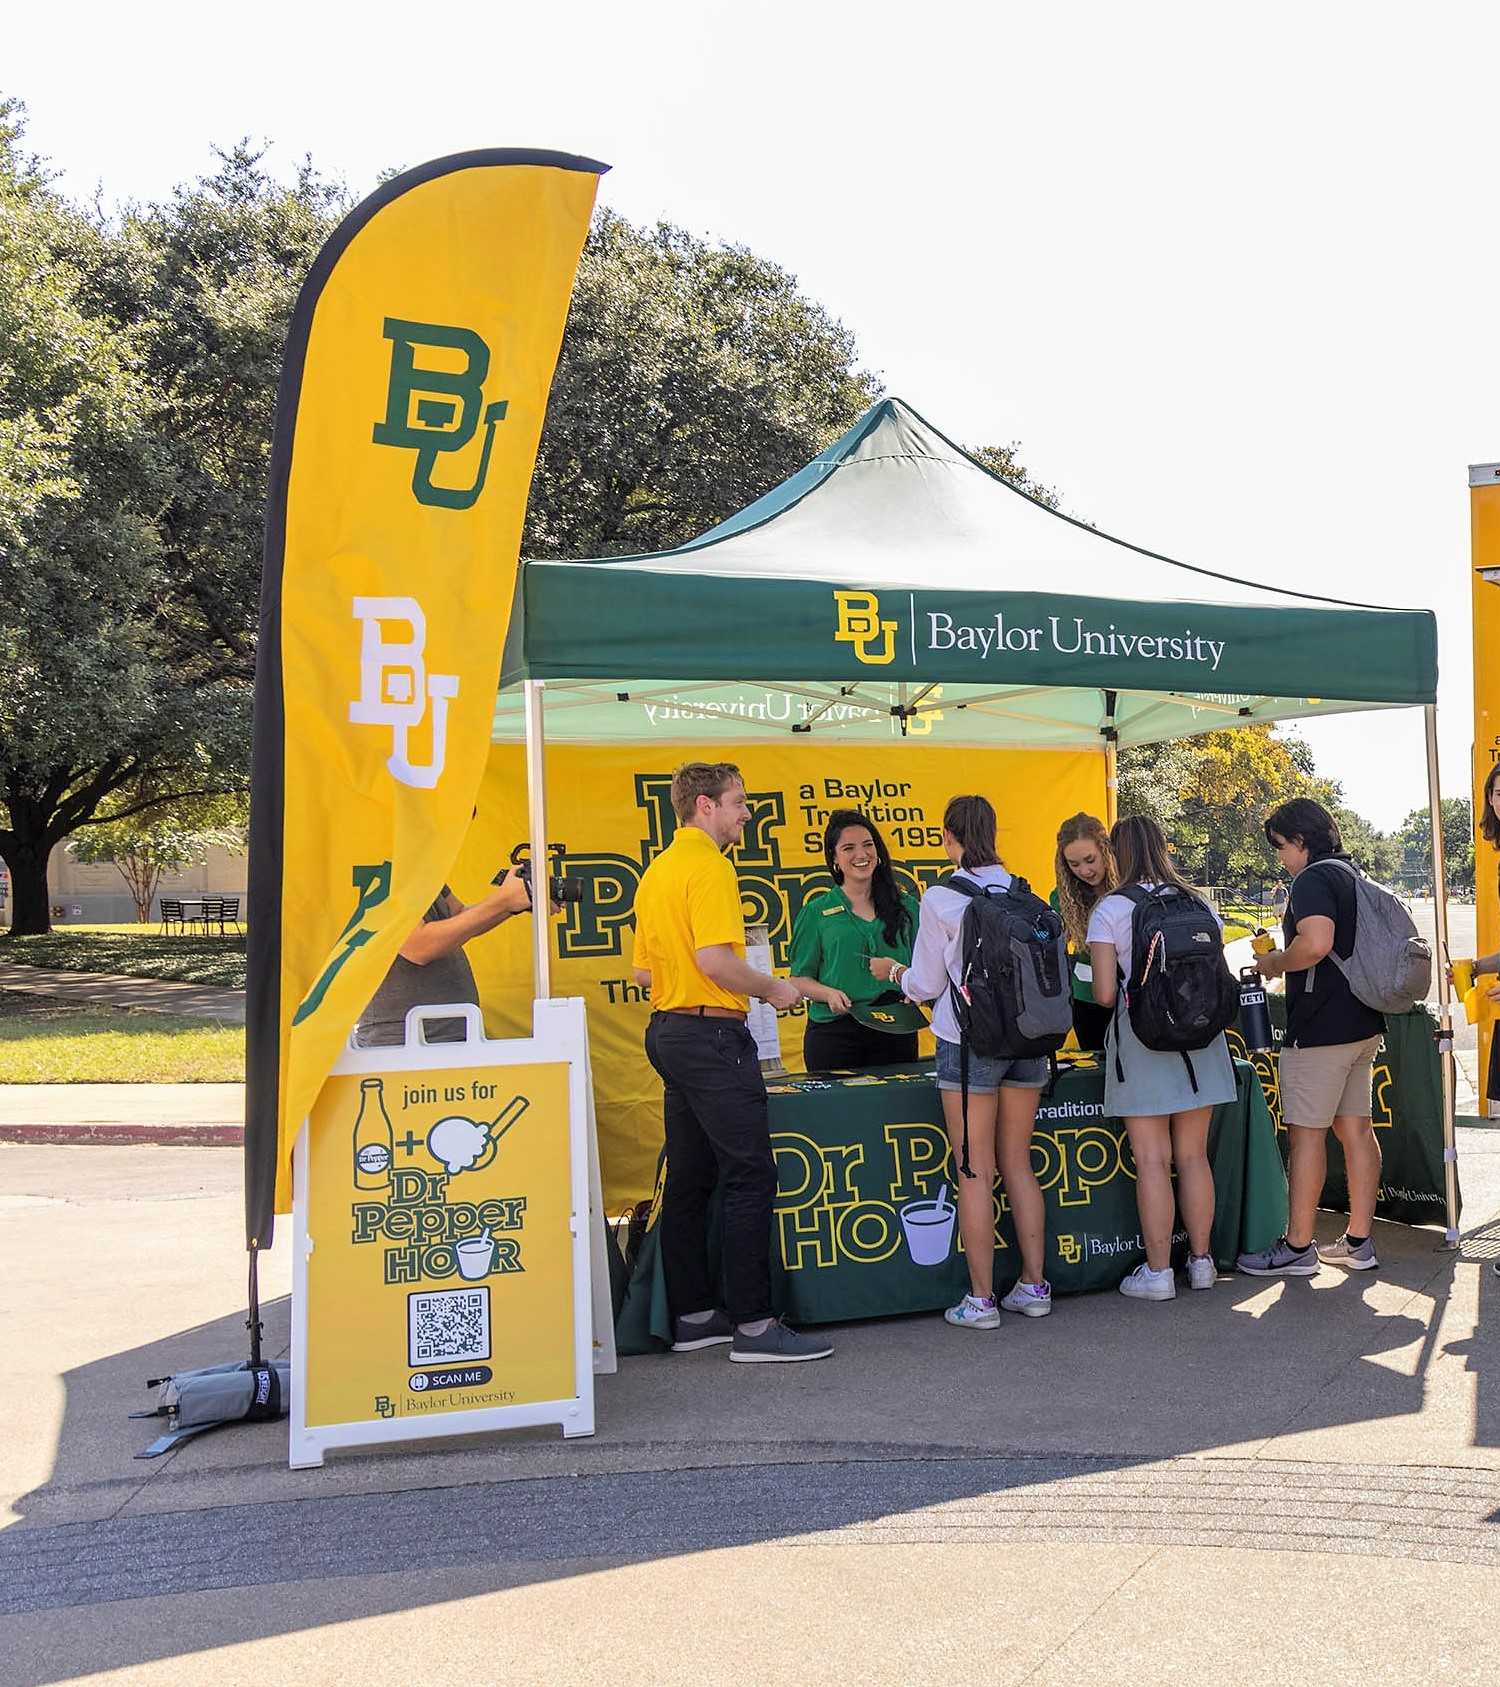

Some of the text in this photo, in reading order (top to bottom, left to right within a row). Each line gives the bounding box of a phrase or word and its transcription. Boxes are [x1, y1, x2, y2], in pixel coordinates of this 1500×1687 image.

[373, 317, 508, 510] BU
[833, 590, 1225, 671] BU Baylor University
[348, 596, 459, 789] BU
[799, 778, 911, 803] a Baylor
[800, 803, 924, 827] Trition
[891, 827, 943, 848] 195
[1241, 993, 1263, 1004] YETI
[402, 1080, 498, 1110] join us for
[388, 1167, 450, 1208] Dr
[352, 1196, 527, 1247] Pepper
[384, 1238, 526, 1285] HOR
[1057, 1234, 1082, 1264] BU
[1090, 1236, 1134, 1256] Baylor
[433, 1372, 482, 1386] SCAN ME
[375, 1389, 516, 1419] BU Baylor University
